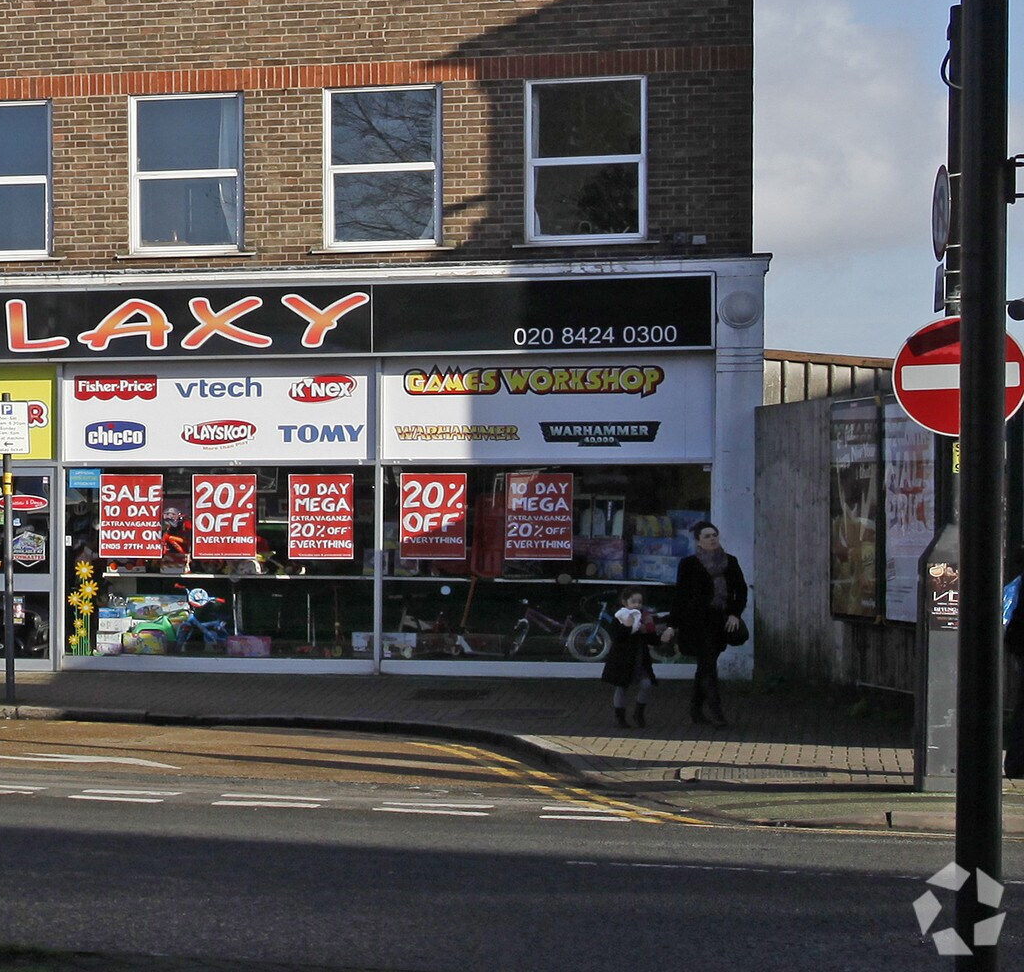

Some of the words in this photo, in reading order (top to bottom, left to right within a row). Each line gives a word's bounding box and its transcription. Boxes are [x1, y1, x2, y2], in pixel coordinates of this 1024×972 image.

[513, 327, 554, 346] 020
[561, 326, 615, 344] 8424
[622, 325, 678, 344] 0300
[77, 380, 155, 393] Fisher-Price
[175, 376, 262, 398] vtech
[405, 365, 498, 395] GAMES
[500, 366, 664, 397] WORKSHOP
[87, 422, 144, 446] chicco
[184, 422, 255, 441] PLAYSKOOL
[278, 424, 365, 444] TOMY
[394, 424, 521, 442] WARHAMMER
[549, 425, 649, 436] WARHAMMER
[101, 484, 162, 503] SALE
[196, 481, 255, 510] 20%
[293, 484, 310, 496] 10
[317, 483, 350, 496] DAY
[402, 480, 464, 509] 20%
[510, 482, 528, 494] 10
[536, 482, 569, 495] DAY
[104, 505, 121, 517] 10
[127, 505, 160, 518] DAY
[295, 497, 351, 512] MEGA
[511, 497, 570, 512] MEGA
[101, 520, 162, 528] EXTRAVAGANZA
[195, 512, 251, 533] OFF
[402, 512, 460, 533] OFF
[508, 514, 572, 522] EXTRAVAGANZA
[101, 530, 136, 541] NOW
[142, 530, 162, 541] ON
[290, 522, 326, 538] 20%
[327, 526, 348, 535] OFF
[507, 522, 544, 538] 20%
[545, 526, 567, 535] OFF
[196, 536, 254, 545] EVERYTHING
[290, 540, 352, 548] EVERYTHING
[403, 536, 463, 544] EVERYTHING
[506, 540, 571, 549] EVERYTHING
